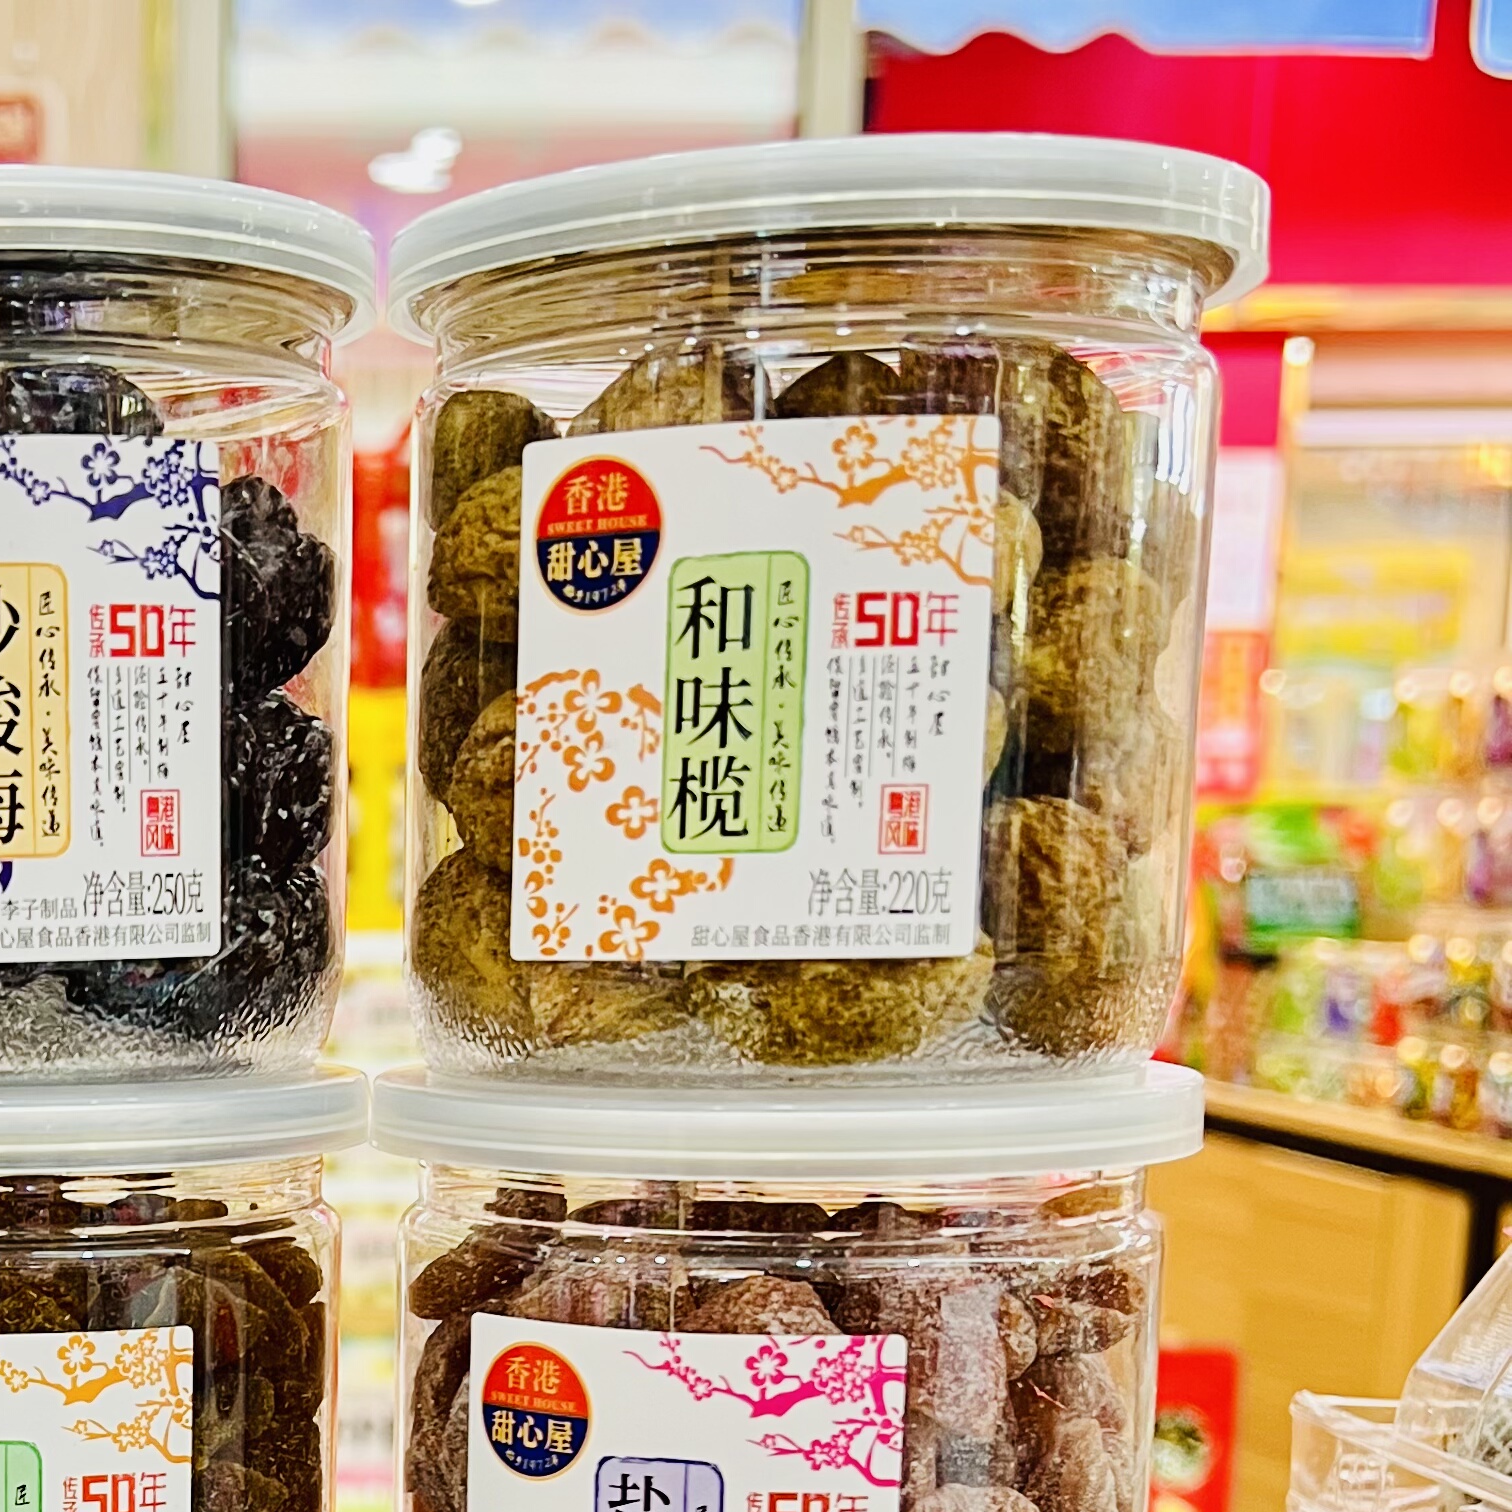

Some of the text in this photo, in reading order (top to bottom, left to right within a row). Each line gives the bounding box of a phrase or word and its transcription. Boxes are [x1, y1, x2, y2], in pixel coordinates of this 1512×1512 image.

[564, 473, 632, 515] 香港
[547, 537, 644, 582] 甜心屋
[667, 575, 755, 841] 和味榄
[1, 897, 78, 921] 李子制品
[690, 921, 952, 949] 甜心屋食品香港有限公司监制
[504, 1355, 563, 1396] 香港
[490, 1409, 574, 1456] 甜心屋
